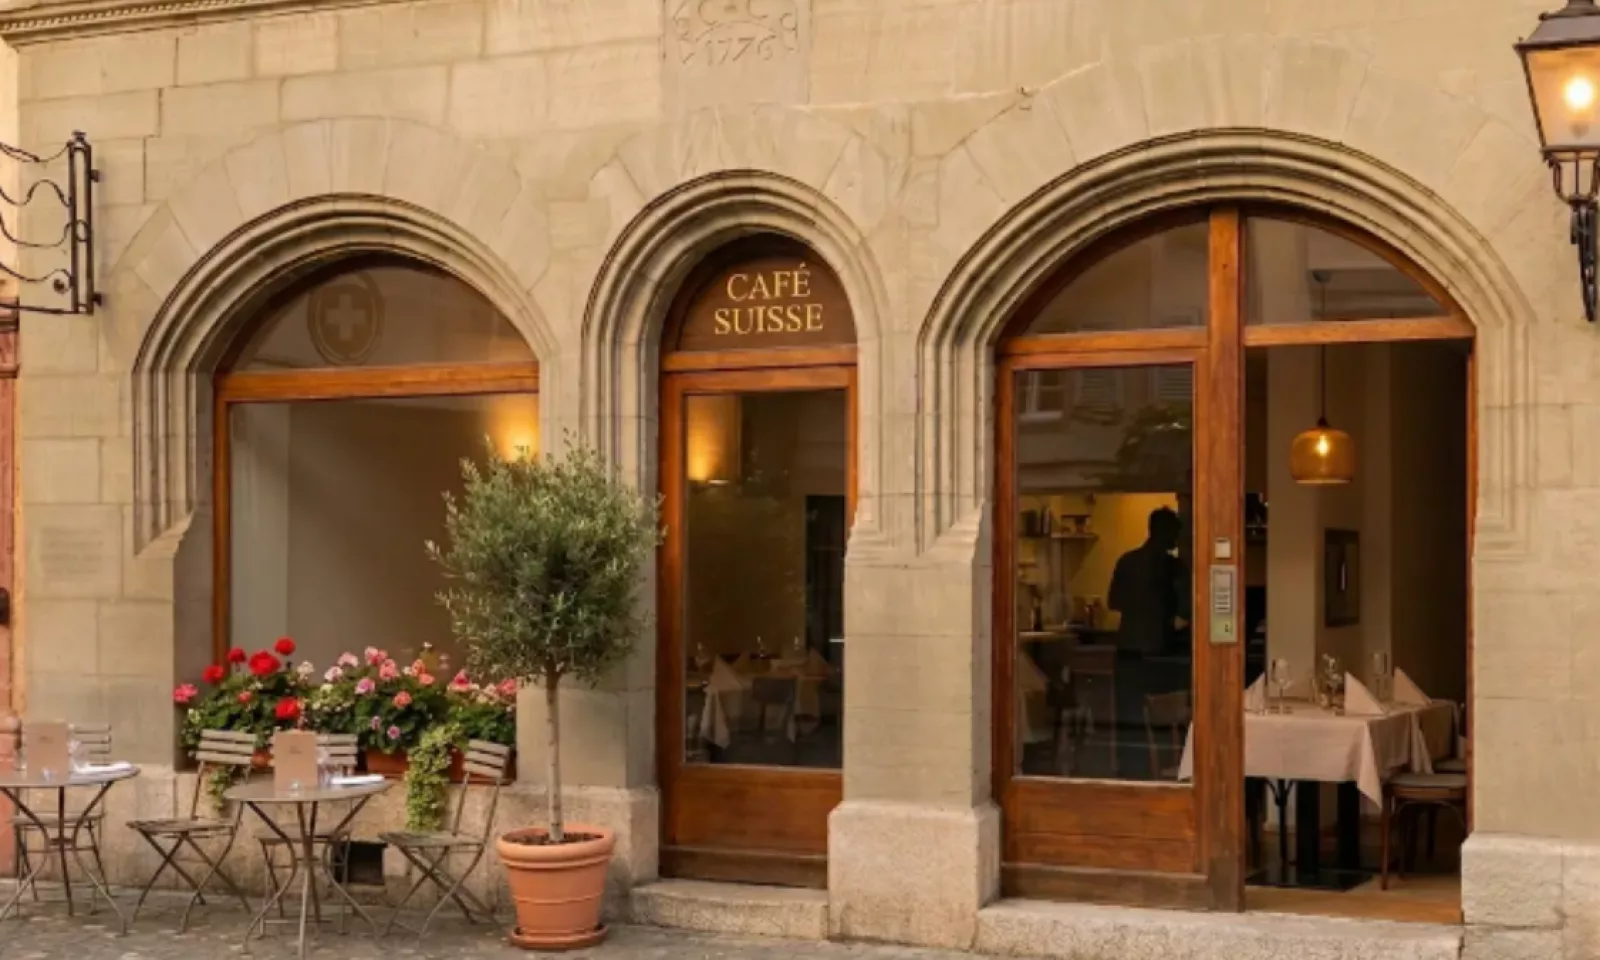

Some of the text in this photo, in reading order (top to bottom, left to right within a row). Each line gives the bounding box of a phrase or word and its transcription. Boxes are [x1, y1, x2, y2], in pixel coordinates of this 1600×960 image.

[705, 34, 777, 66] 1776
[727, 262, 811, 301] CAFÉ
[714, 303, 824, 335] SUISSE
